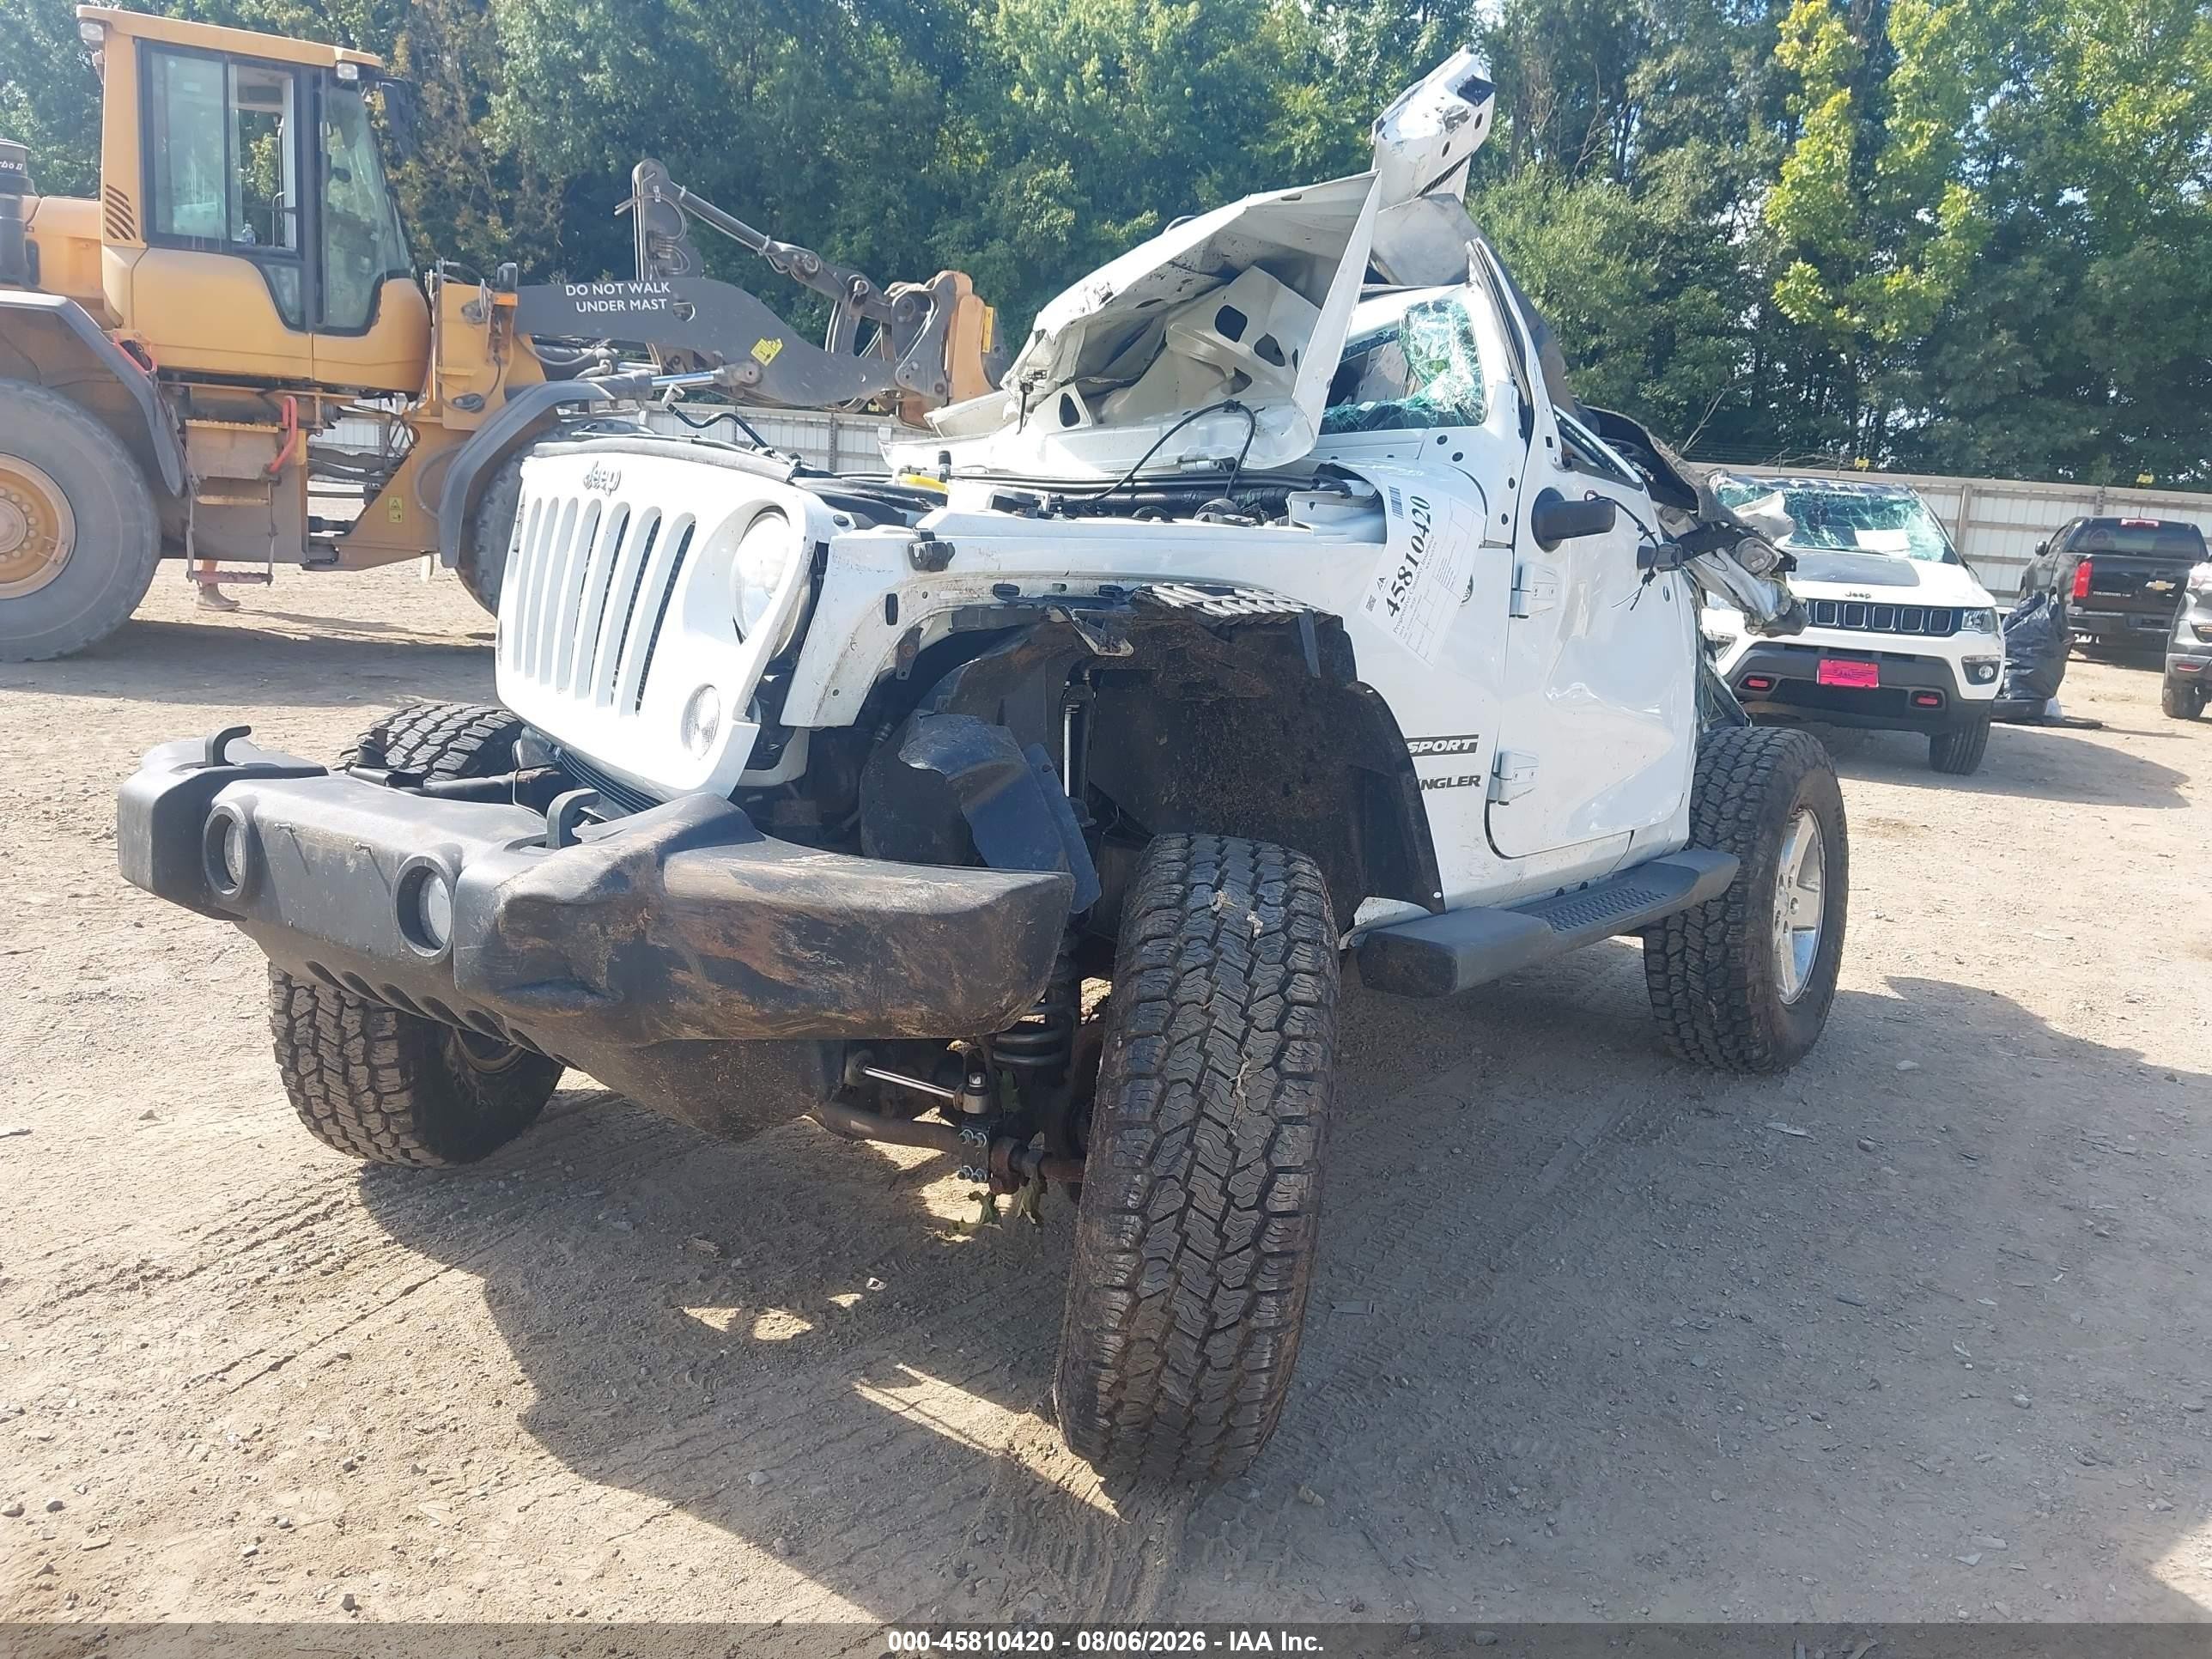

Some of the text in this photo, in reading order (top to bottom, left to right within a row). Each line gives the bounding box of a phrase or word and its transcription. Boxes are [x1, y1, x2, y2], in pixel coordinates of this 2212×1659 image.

[566, 282, 670, 296] DO NOT WALK
[575, 298, 667, 313] UNDER MAST
[583, 460, 621, 497] Jeep
[1386, 495, 1431, 617] 45810420
[1845, 591, 1871, 599] Jeep
[1407, 739, 1478, 754] SPORT
[1419, 775, 1481, 790] NGLER
